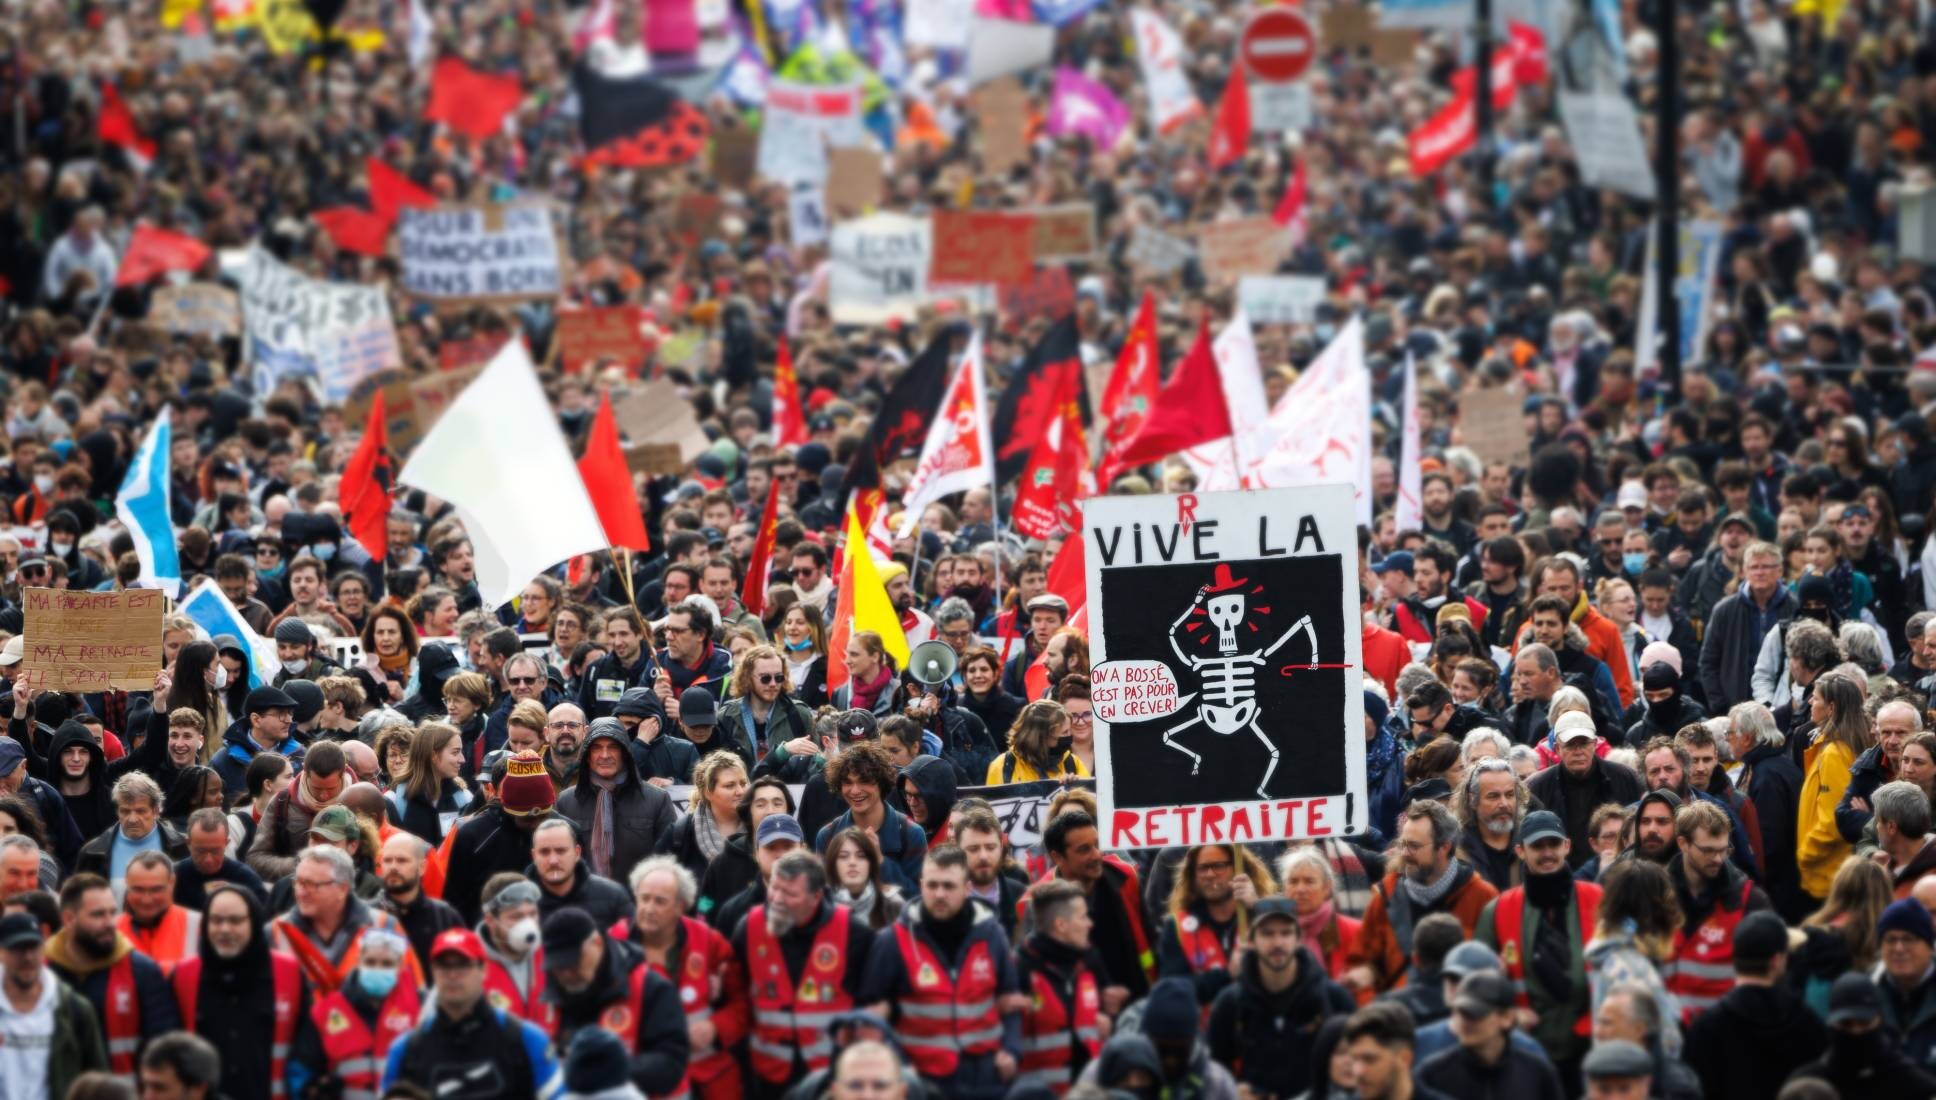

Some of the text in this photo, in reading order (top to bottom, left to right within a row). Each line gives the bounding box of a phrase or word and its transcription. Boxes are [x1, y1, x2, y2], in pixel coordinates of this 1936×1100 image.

[1259, 514, 1326, 558] LA
[29, 593, 50, 611] MA
[128, 592, 158, 608] EST
[33, 644, 68, 663] MA
[1092, 664, 1169, 684] ON A BOSSÉ,
[1092, 683, 1175, 702] C'EST PAS POUR
[1100, 696, 1177, 718] EN CREVER!
